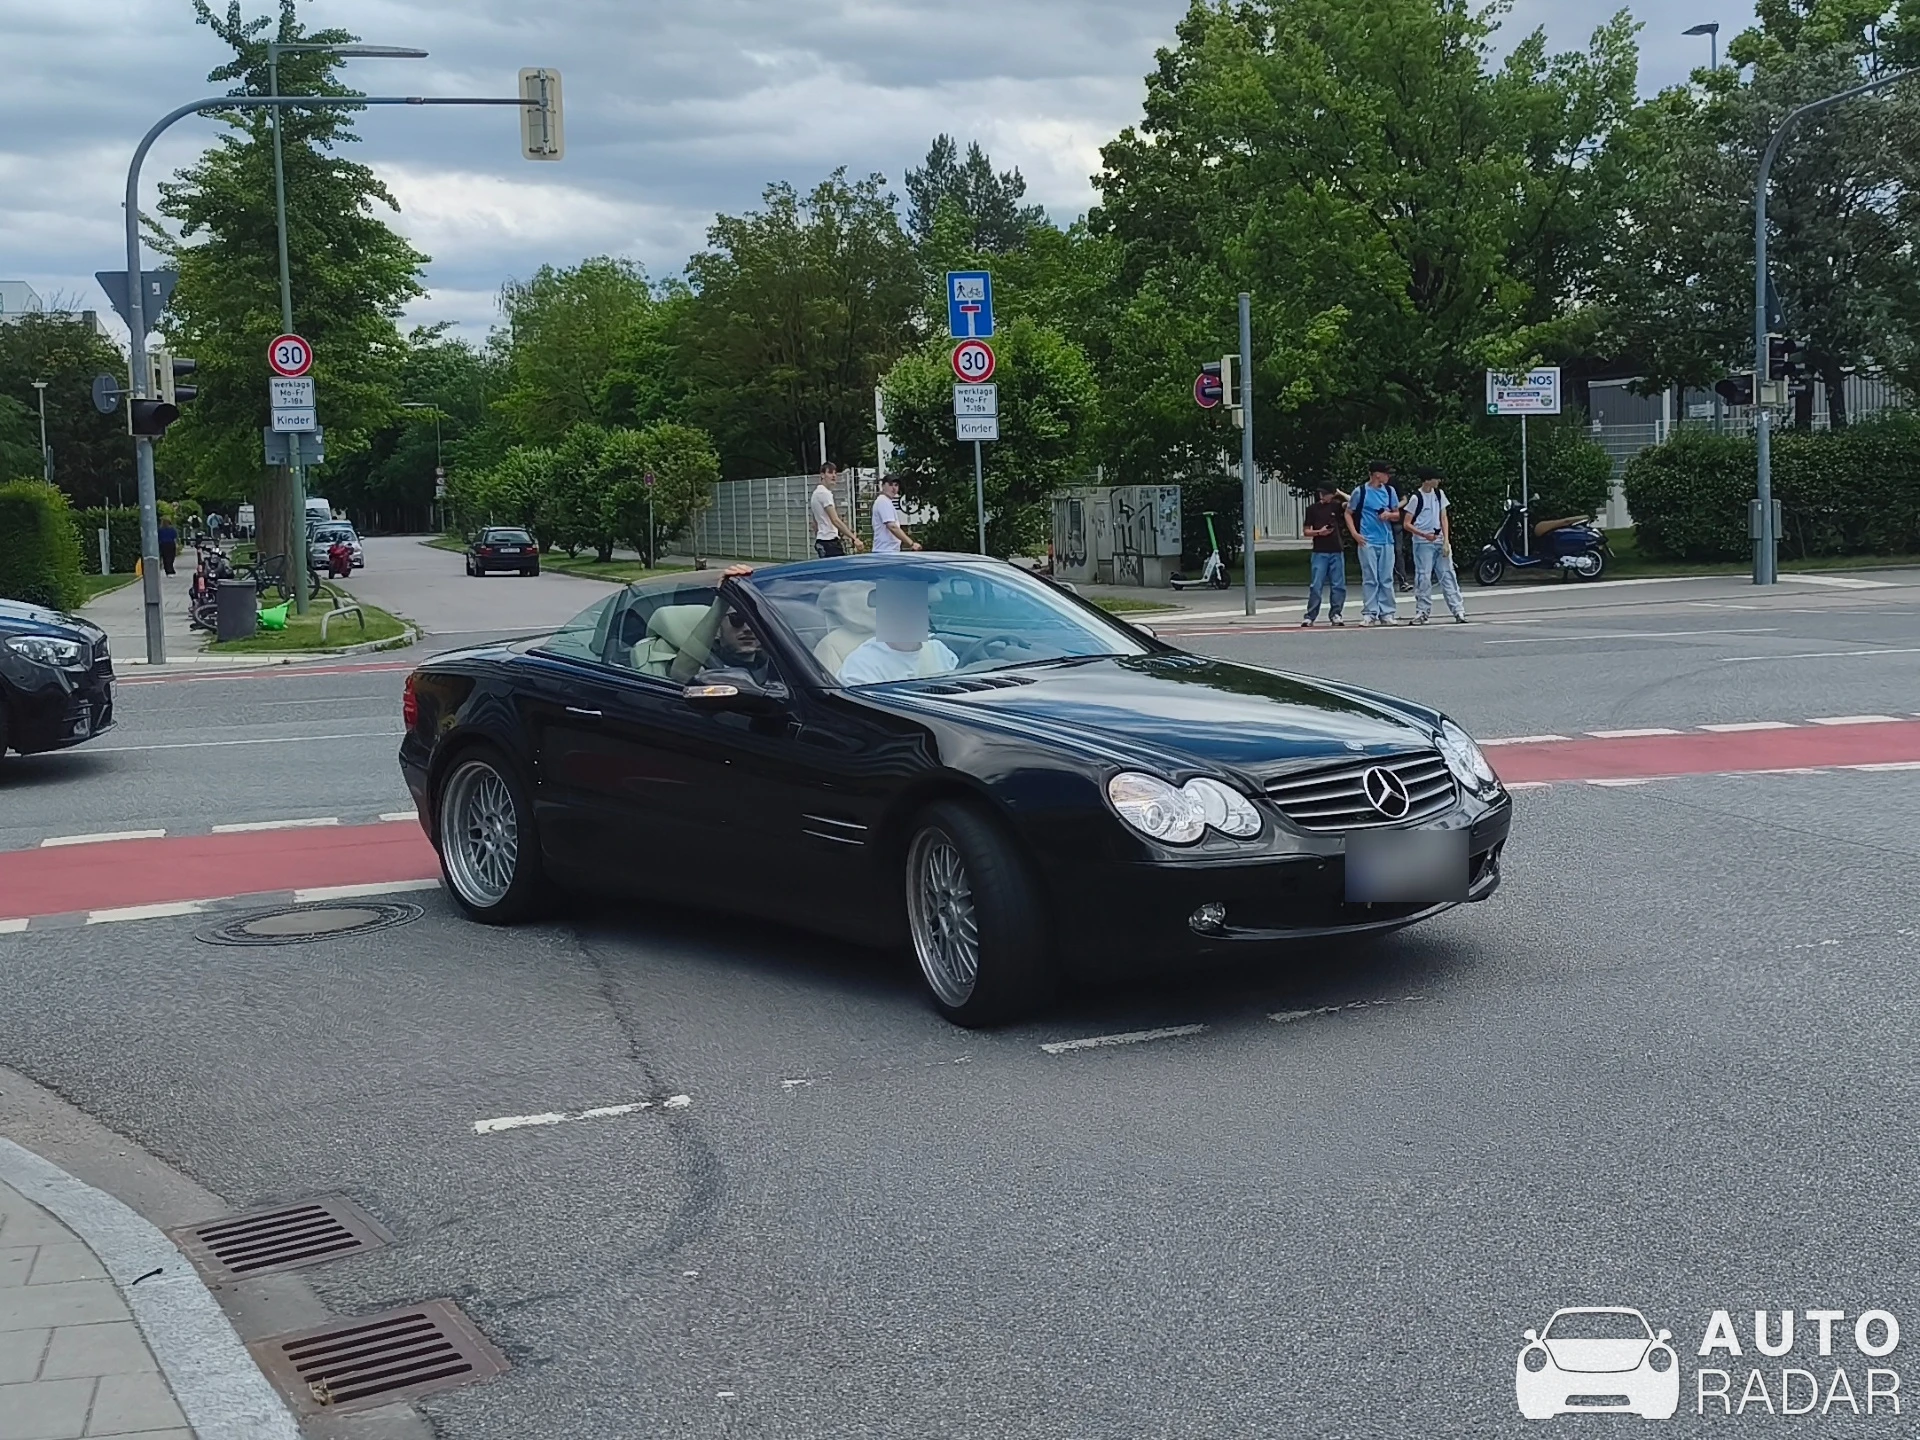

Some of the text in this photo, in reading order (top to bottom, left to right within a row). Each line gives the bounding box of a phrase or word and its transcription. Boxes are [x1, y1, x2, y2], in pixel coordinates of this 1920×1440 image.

[278, 346, 302, 364] 30
[962, 351, 985, 370] 30
[274, 381, 310, 390] werktags
[1494, 375, 1553, 387] MYKNOS
[957, 388, 993, 397] werktags
[277, 416, 310, 425] Kinder
[961, 424, 992, 433] Kinder
